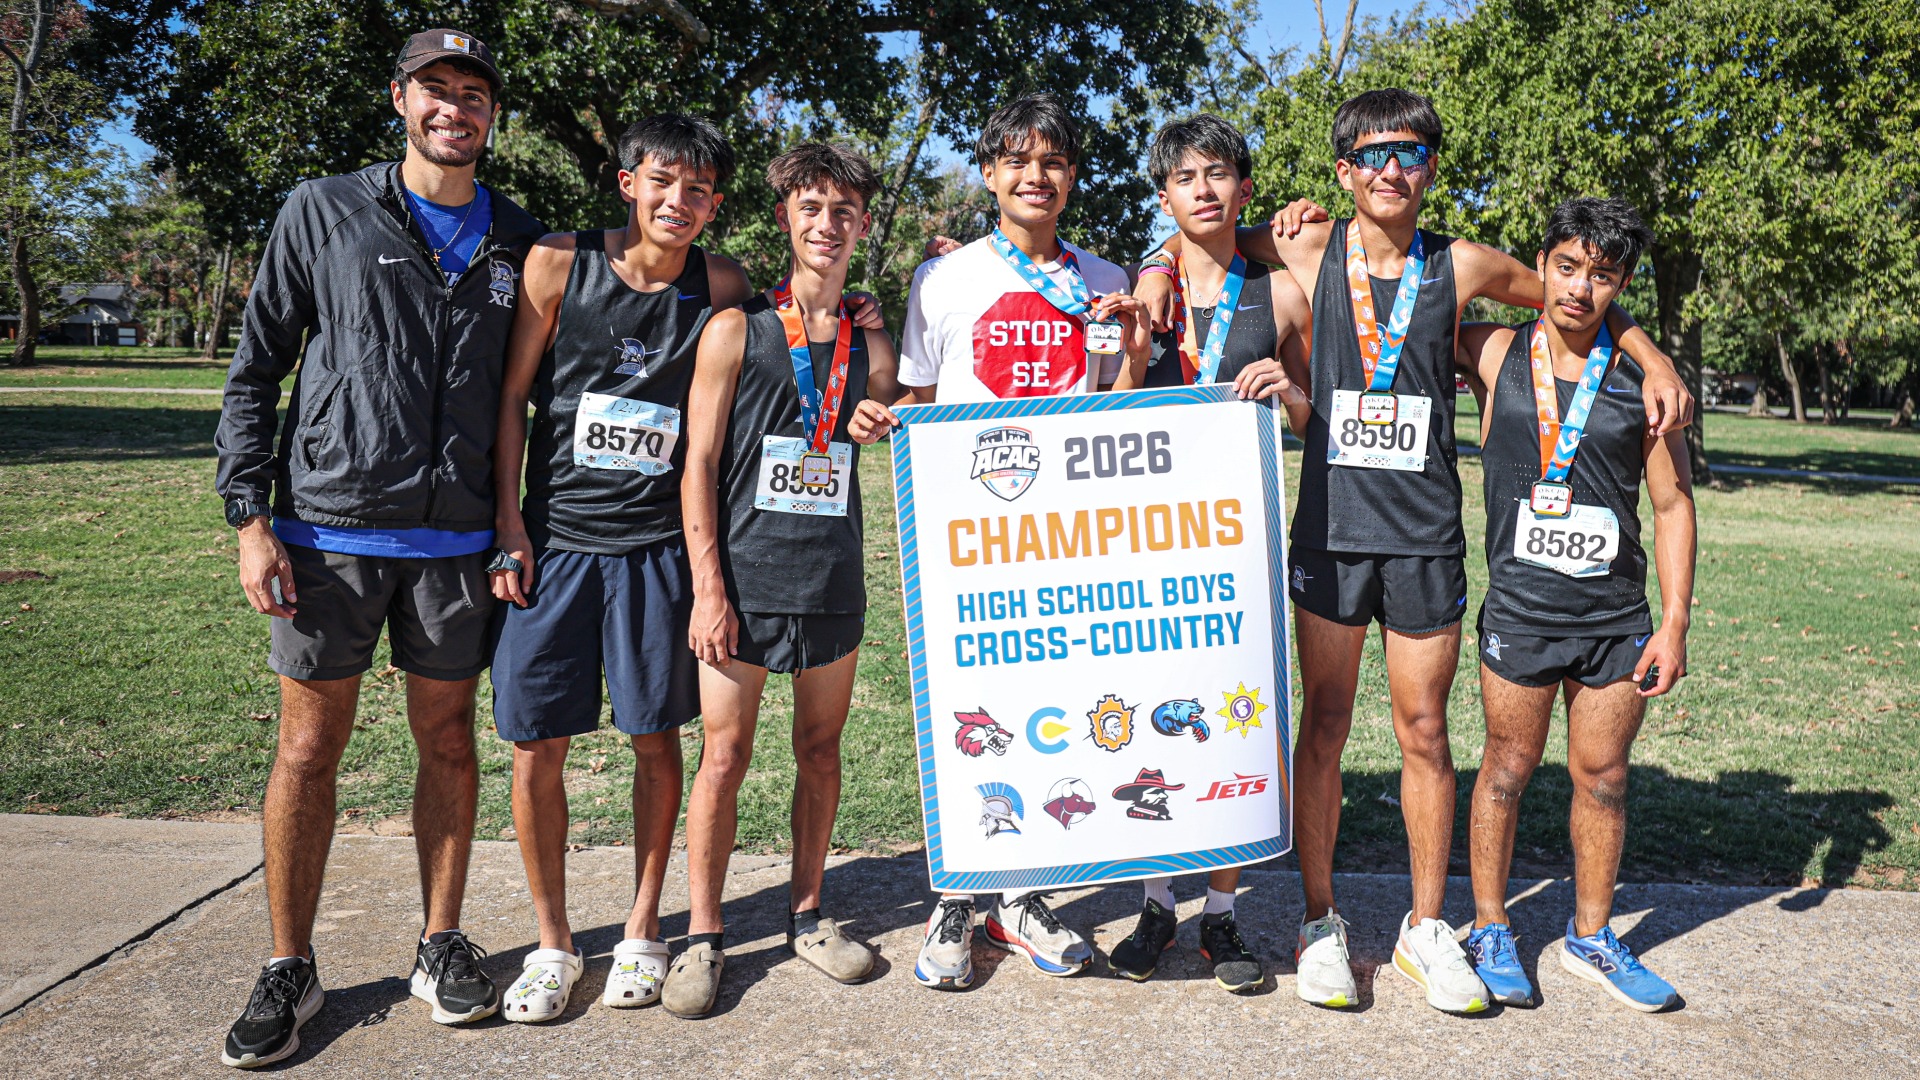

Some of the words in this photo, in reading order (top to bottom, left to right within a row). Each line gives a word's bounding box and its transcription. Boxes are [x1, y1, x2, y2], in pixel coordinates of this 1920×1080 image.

[488, 290, 513, 309] XC
[989, 320, 1073, 347] STOP
[1012, 361, 1050, 388] SE
[586, 422, 665, 458] 8570
[1340, 418, 1416, 452] 8590
[970, 446, 1040, 480] ACAC
[1064, 430, 1173, 481] 2026
[947, 498, 1244, 567] CHAMPIONS
[1526, 526, 1607, 563] 8582
[957, 589, 1027, 623] HIGH
[1037, 579, 1153, 617] SCHOOL
[1161, 572, 1236, 606] BOYS
[954, 611, 1245, 668] CROSS-COUNTRY
[1196, 778, 1268, 802] JETS
